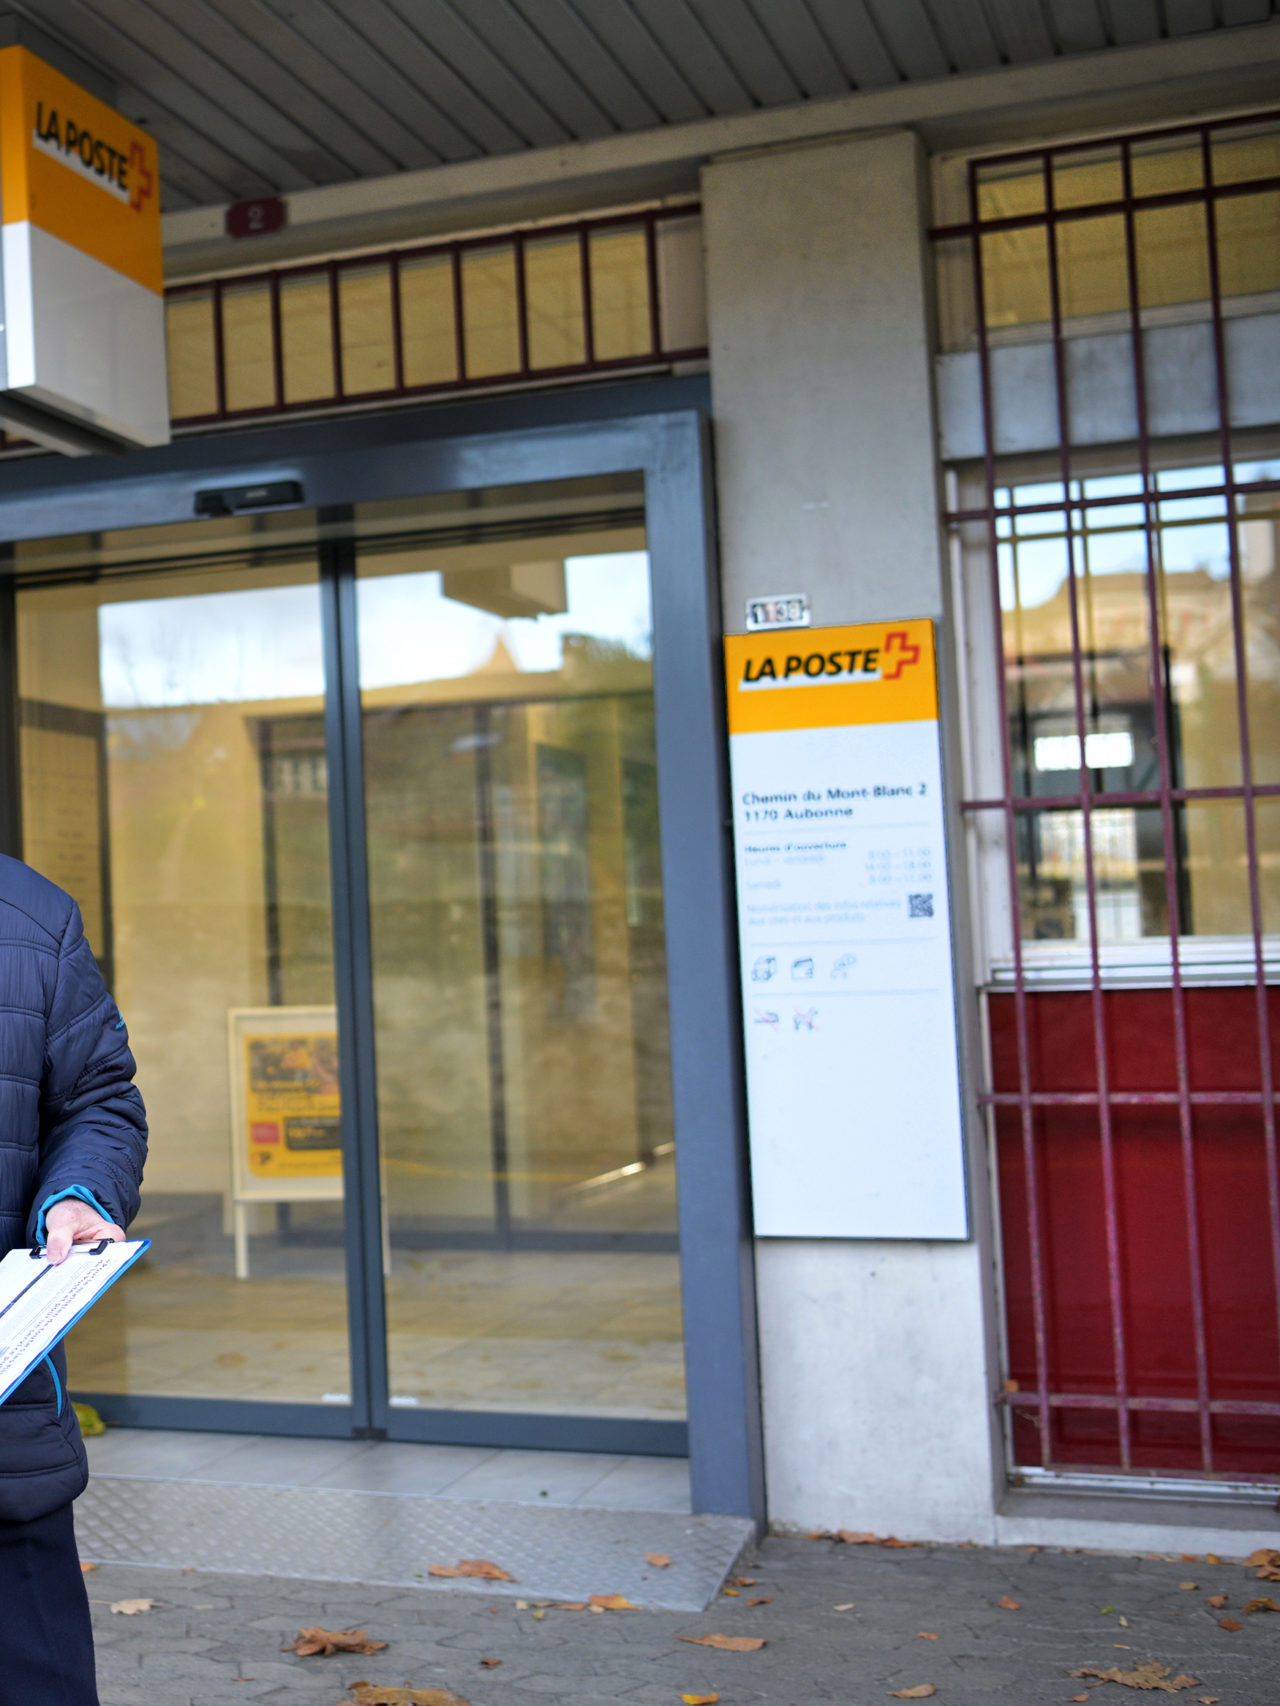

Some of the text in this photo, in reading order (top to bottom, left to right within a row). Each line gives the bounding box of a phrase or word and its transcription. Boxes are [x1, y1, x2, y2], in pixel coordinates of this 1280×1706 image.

[36, 101, 129, 192] LA POSTE
[752, 601, 801, 622] 1138
[742, 648, 880, 682] LA POSTE
[742, 782, 927, 806] Chemin du Mont-Blanc 2
[744, 806, 854, 822] 1170 Aubonne
